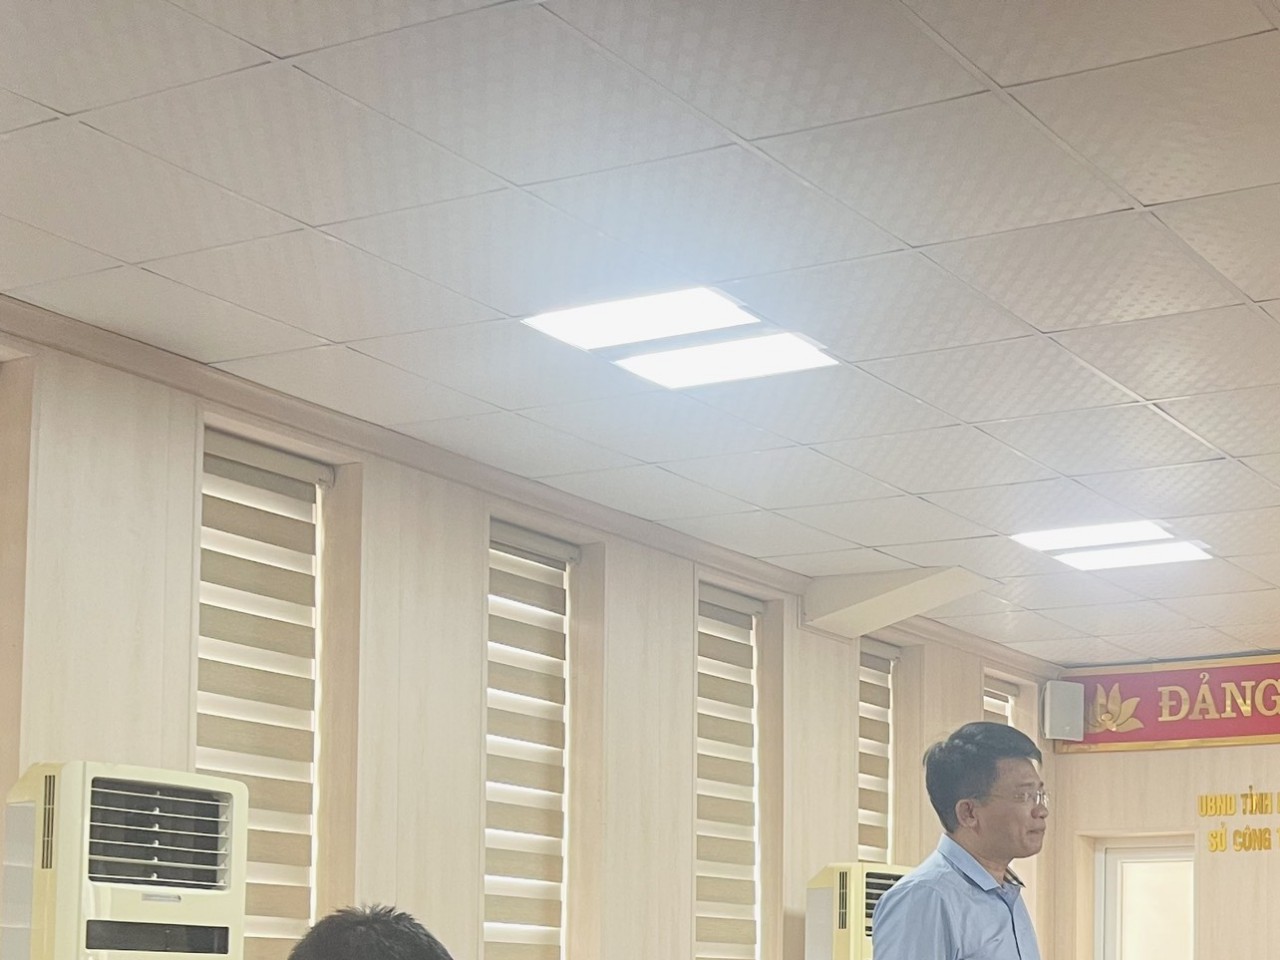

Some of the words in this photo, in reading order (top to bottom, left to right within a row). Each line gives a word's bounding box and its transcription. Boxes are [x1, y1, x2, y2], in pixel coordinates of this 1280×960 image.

[1197, 794, 1237, 817] UBND
[1240, 785, 1273, 816] TỈNH
[1232, 825, 1272, 852] CÔNG
